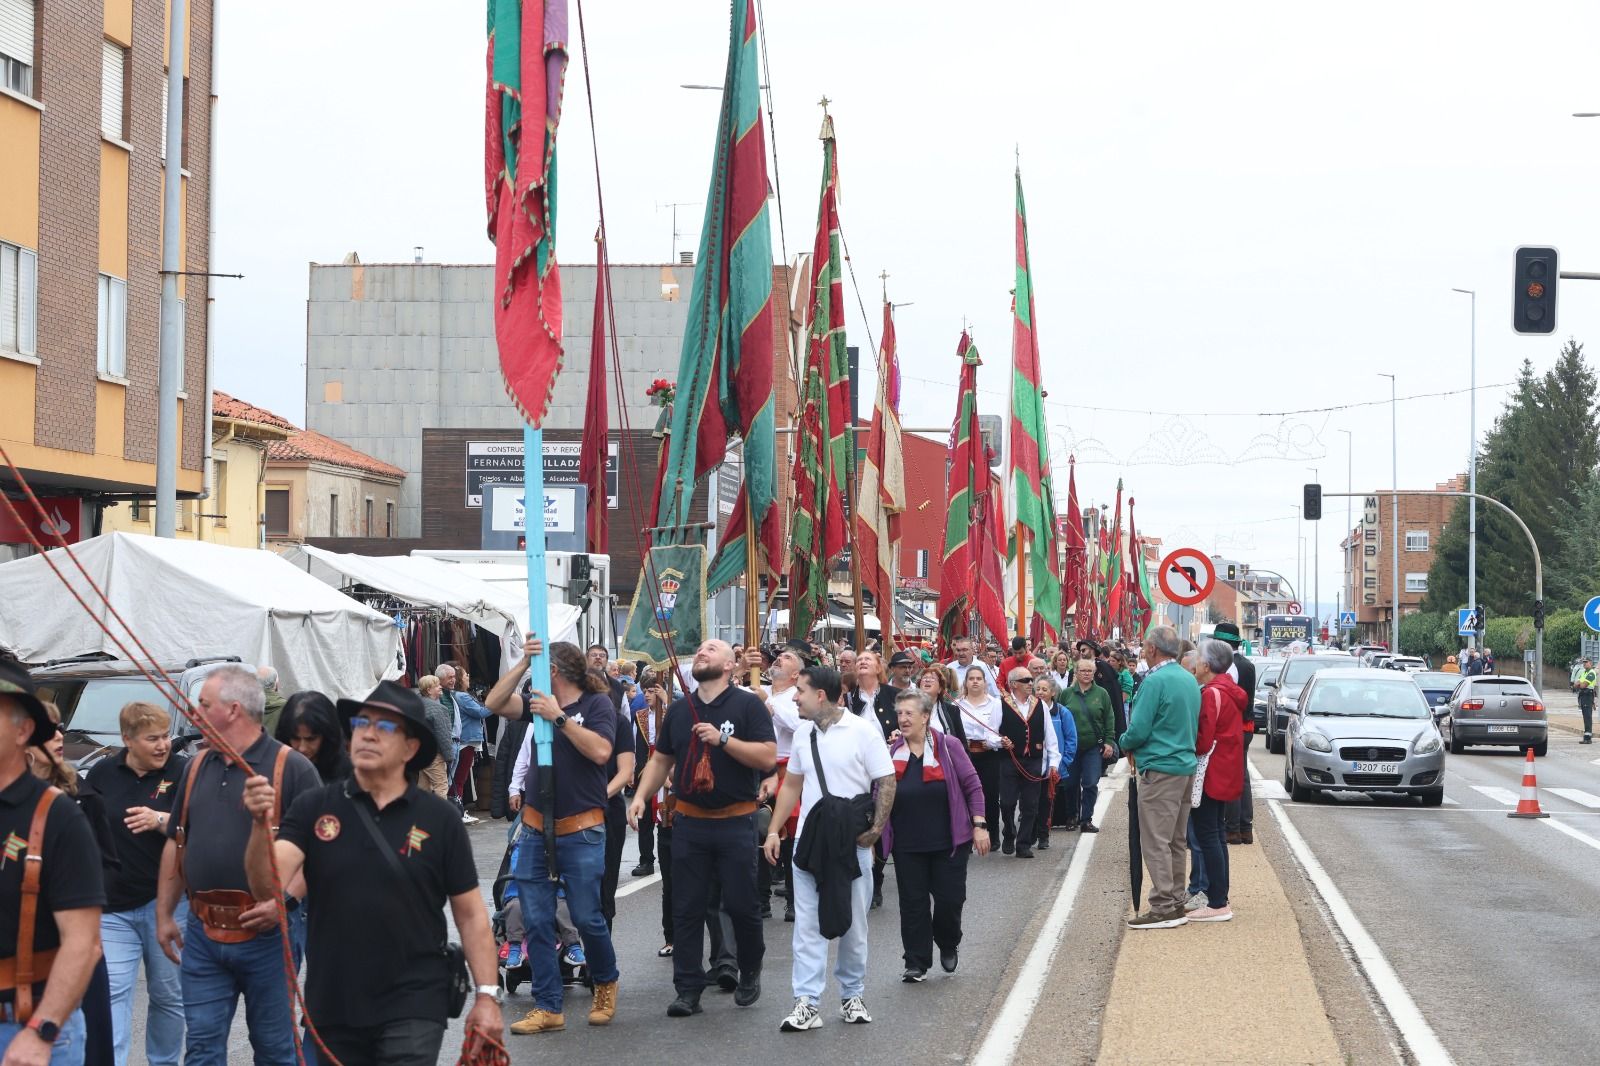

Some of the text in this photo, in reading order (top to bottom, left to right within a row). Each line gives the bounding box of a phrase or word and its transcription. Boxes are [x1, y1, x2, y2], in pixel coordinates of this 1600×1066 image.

[474, 458, 525, 467] FERNÁNDE
[1364, 497, 1377, 606] MUEBLES
[1357, 763, 1378, 771] 9207
